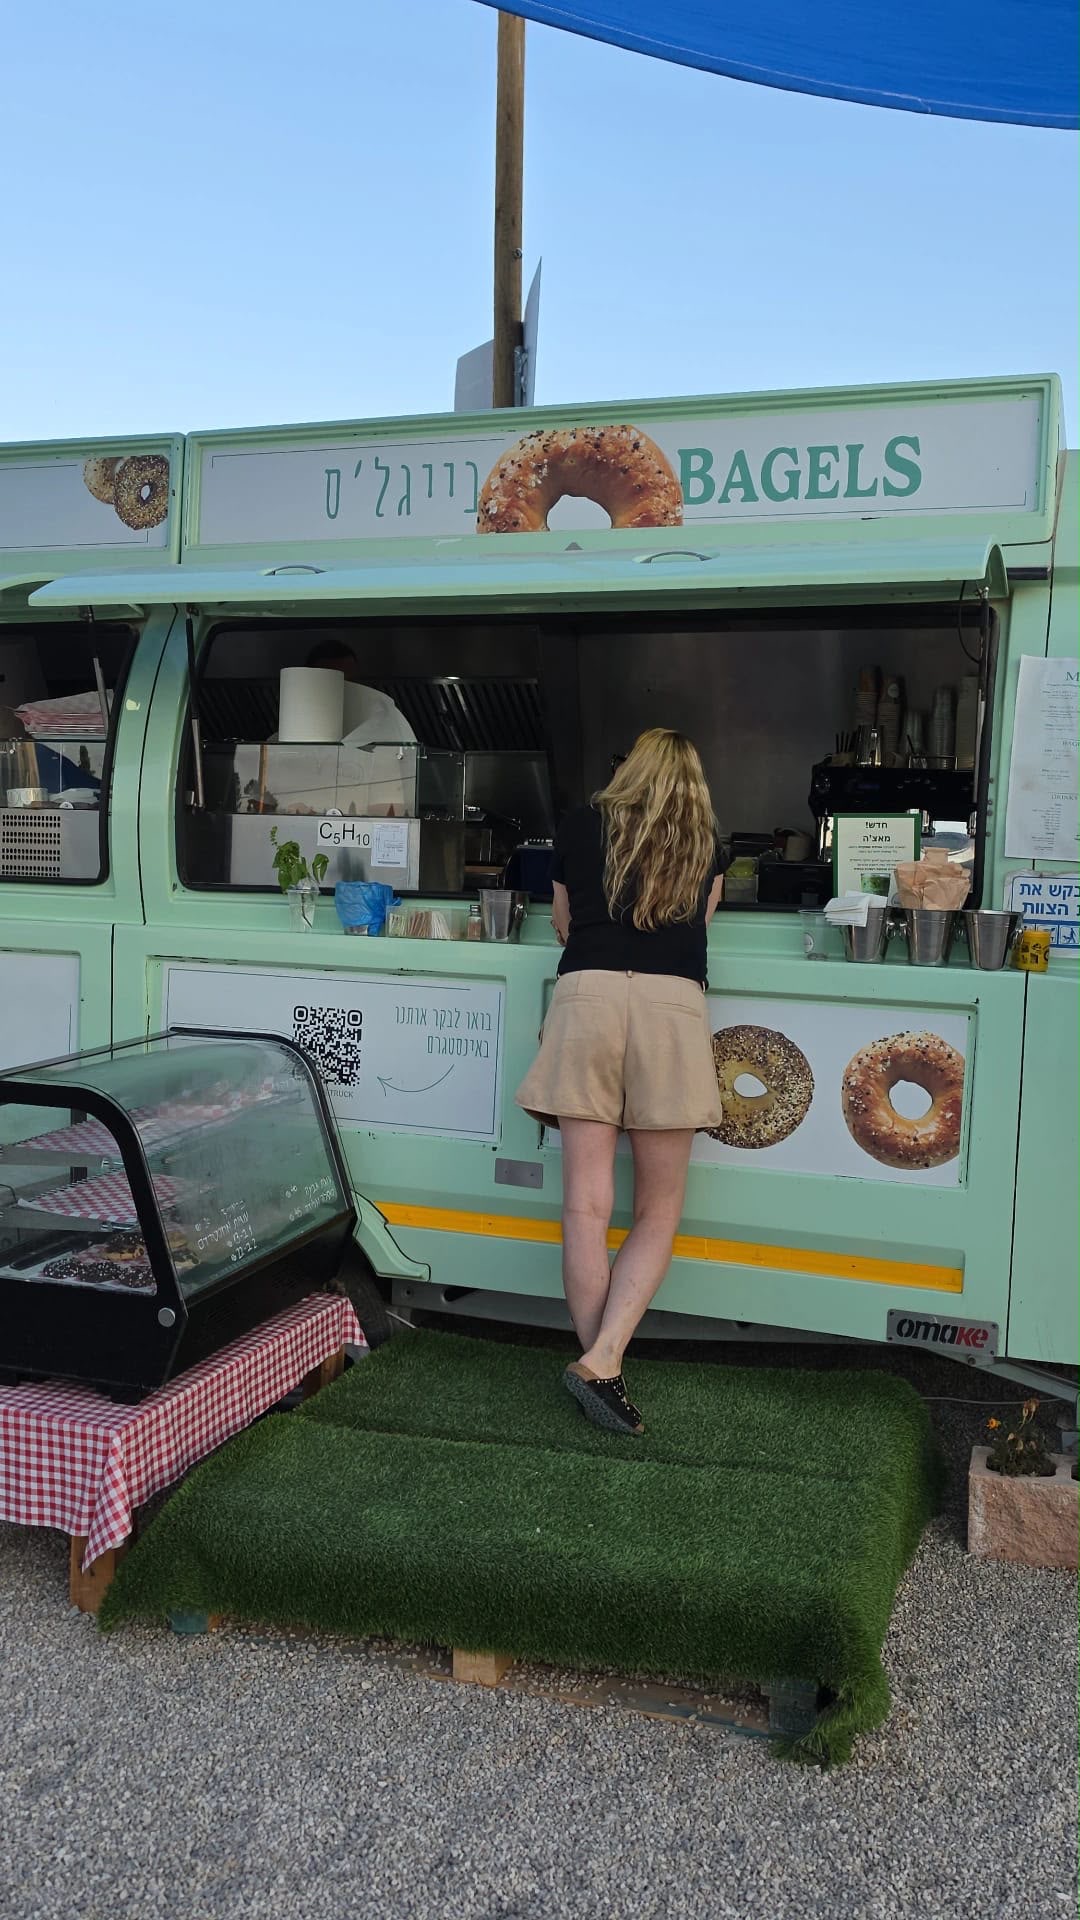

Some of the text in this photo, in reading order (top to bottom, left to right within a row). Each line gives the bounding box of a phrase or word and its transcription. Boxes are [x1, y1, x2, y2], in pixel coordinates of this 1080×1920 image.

[677, 435, 922, 505] BAGELS
[865, 821, 888, 829] חדש!
[862, 834, 891, 842] מאצ'ה
[1019, 883, 1042, 896] את
[1022, 902, 1069, 916] הצוות
[395, 1006, 492, 1031] בואו לבקר אותנו
[427, 1035, 489, 1058] באינסטגרם
